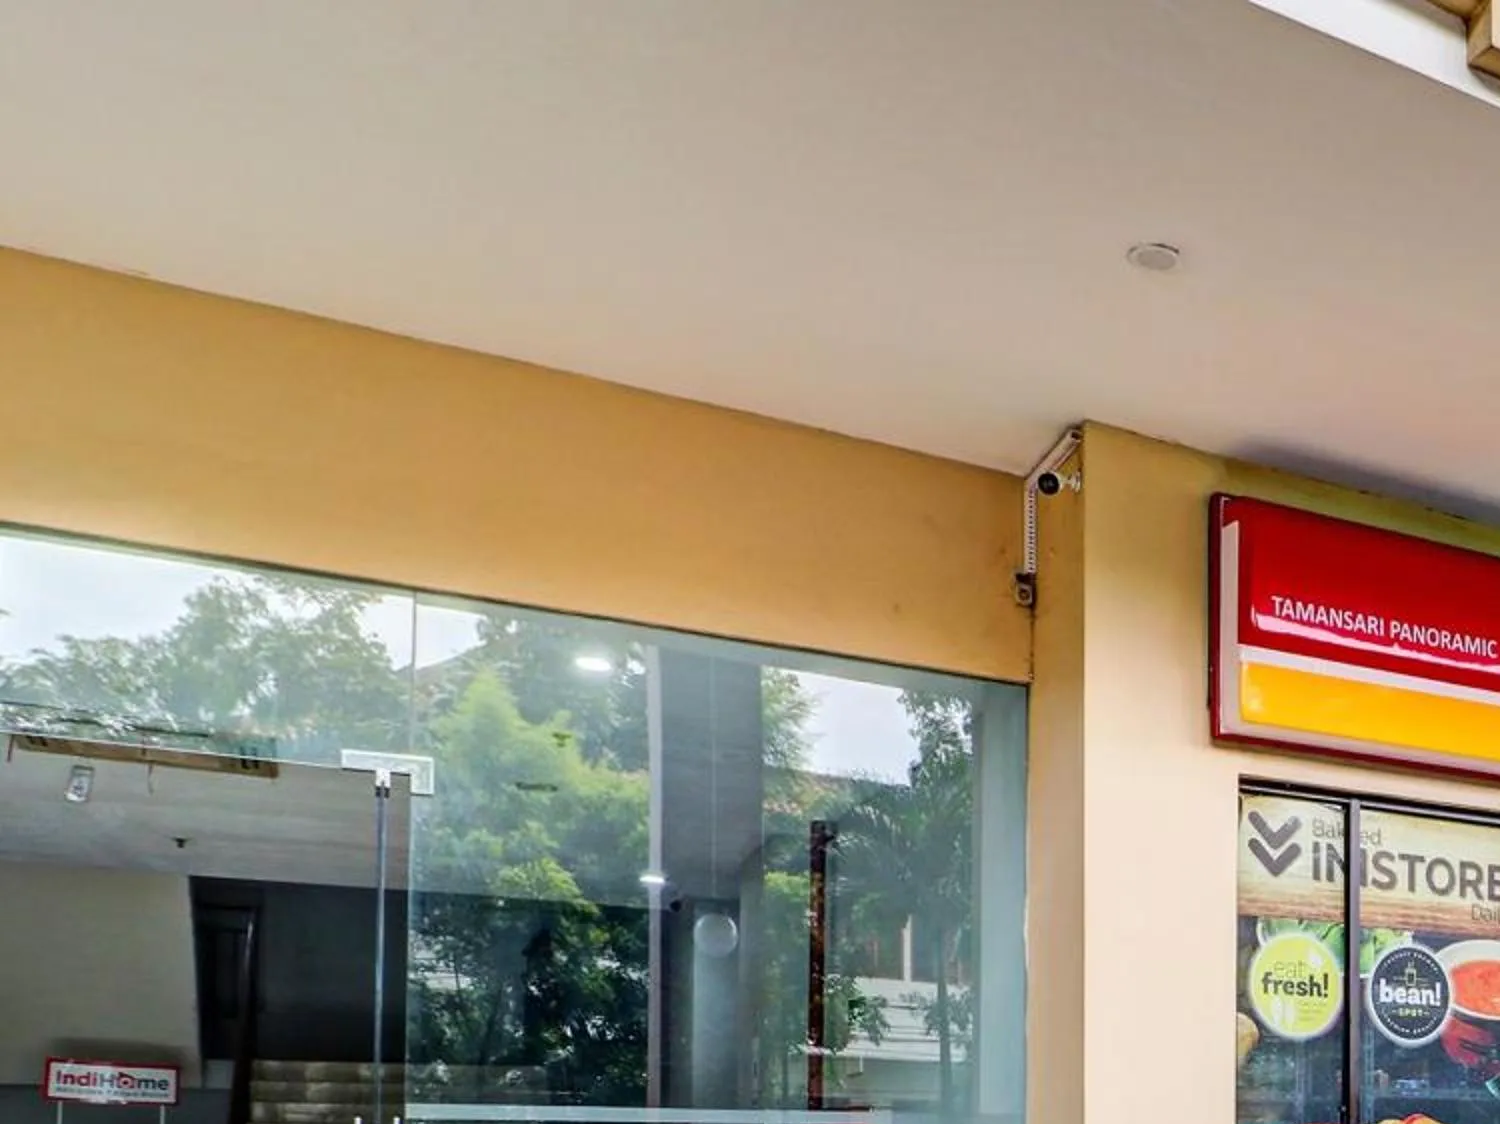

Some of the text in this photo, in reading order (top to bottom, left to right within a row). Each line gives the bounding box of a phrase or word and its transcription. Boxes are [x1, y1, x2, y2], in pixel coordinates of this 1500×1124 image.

[1271, 595, 1498, 658] TAMANSARI PANORAMIC
[1262, 972, 1329, 998] fresh!
[1378, 979, 1441, 1006] bean!
[55, 1069, 170, 1091] IndiHome
